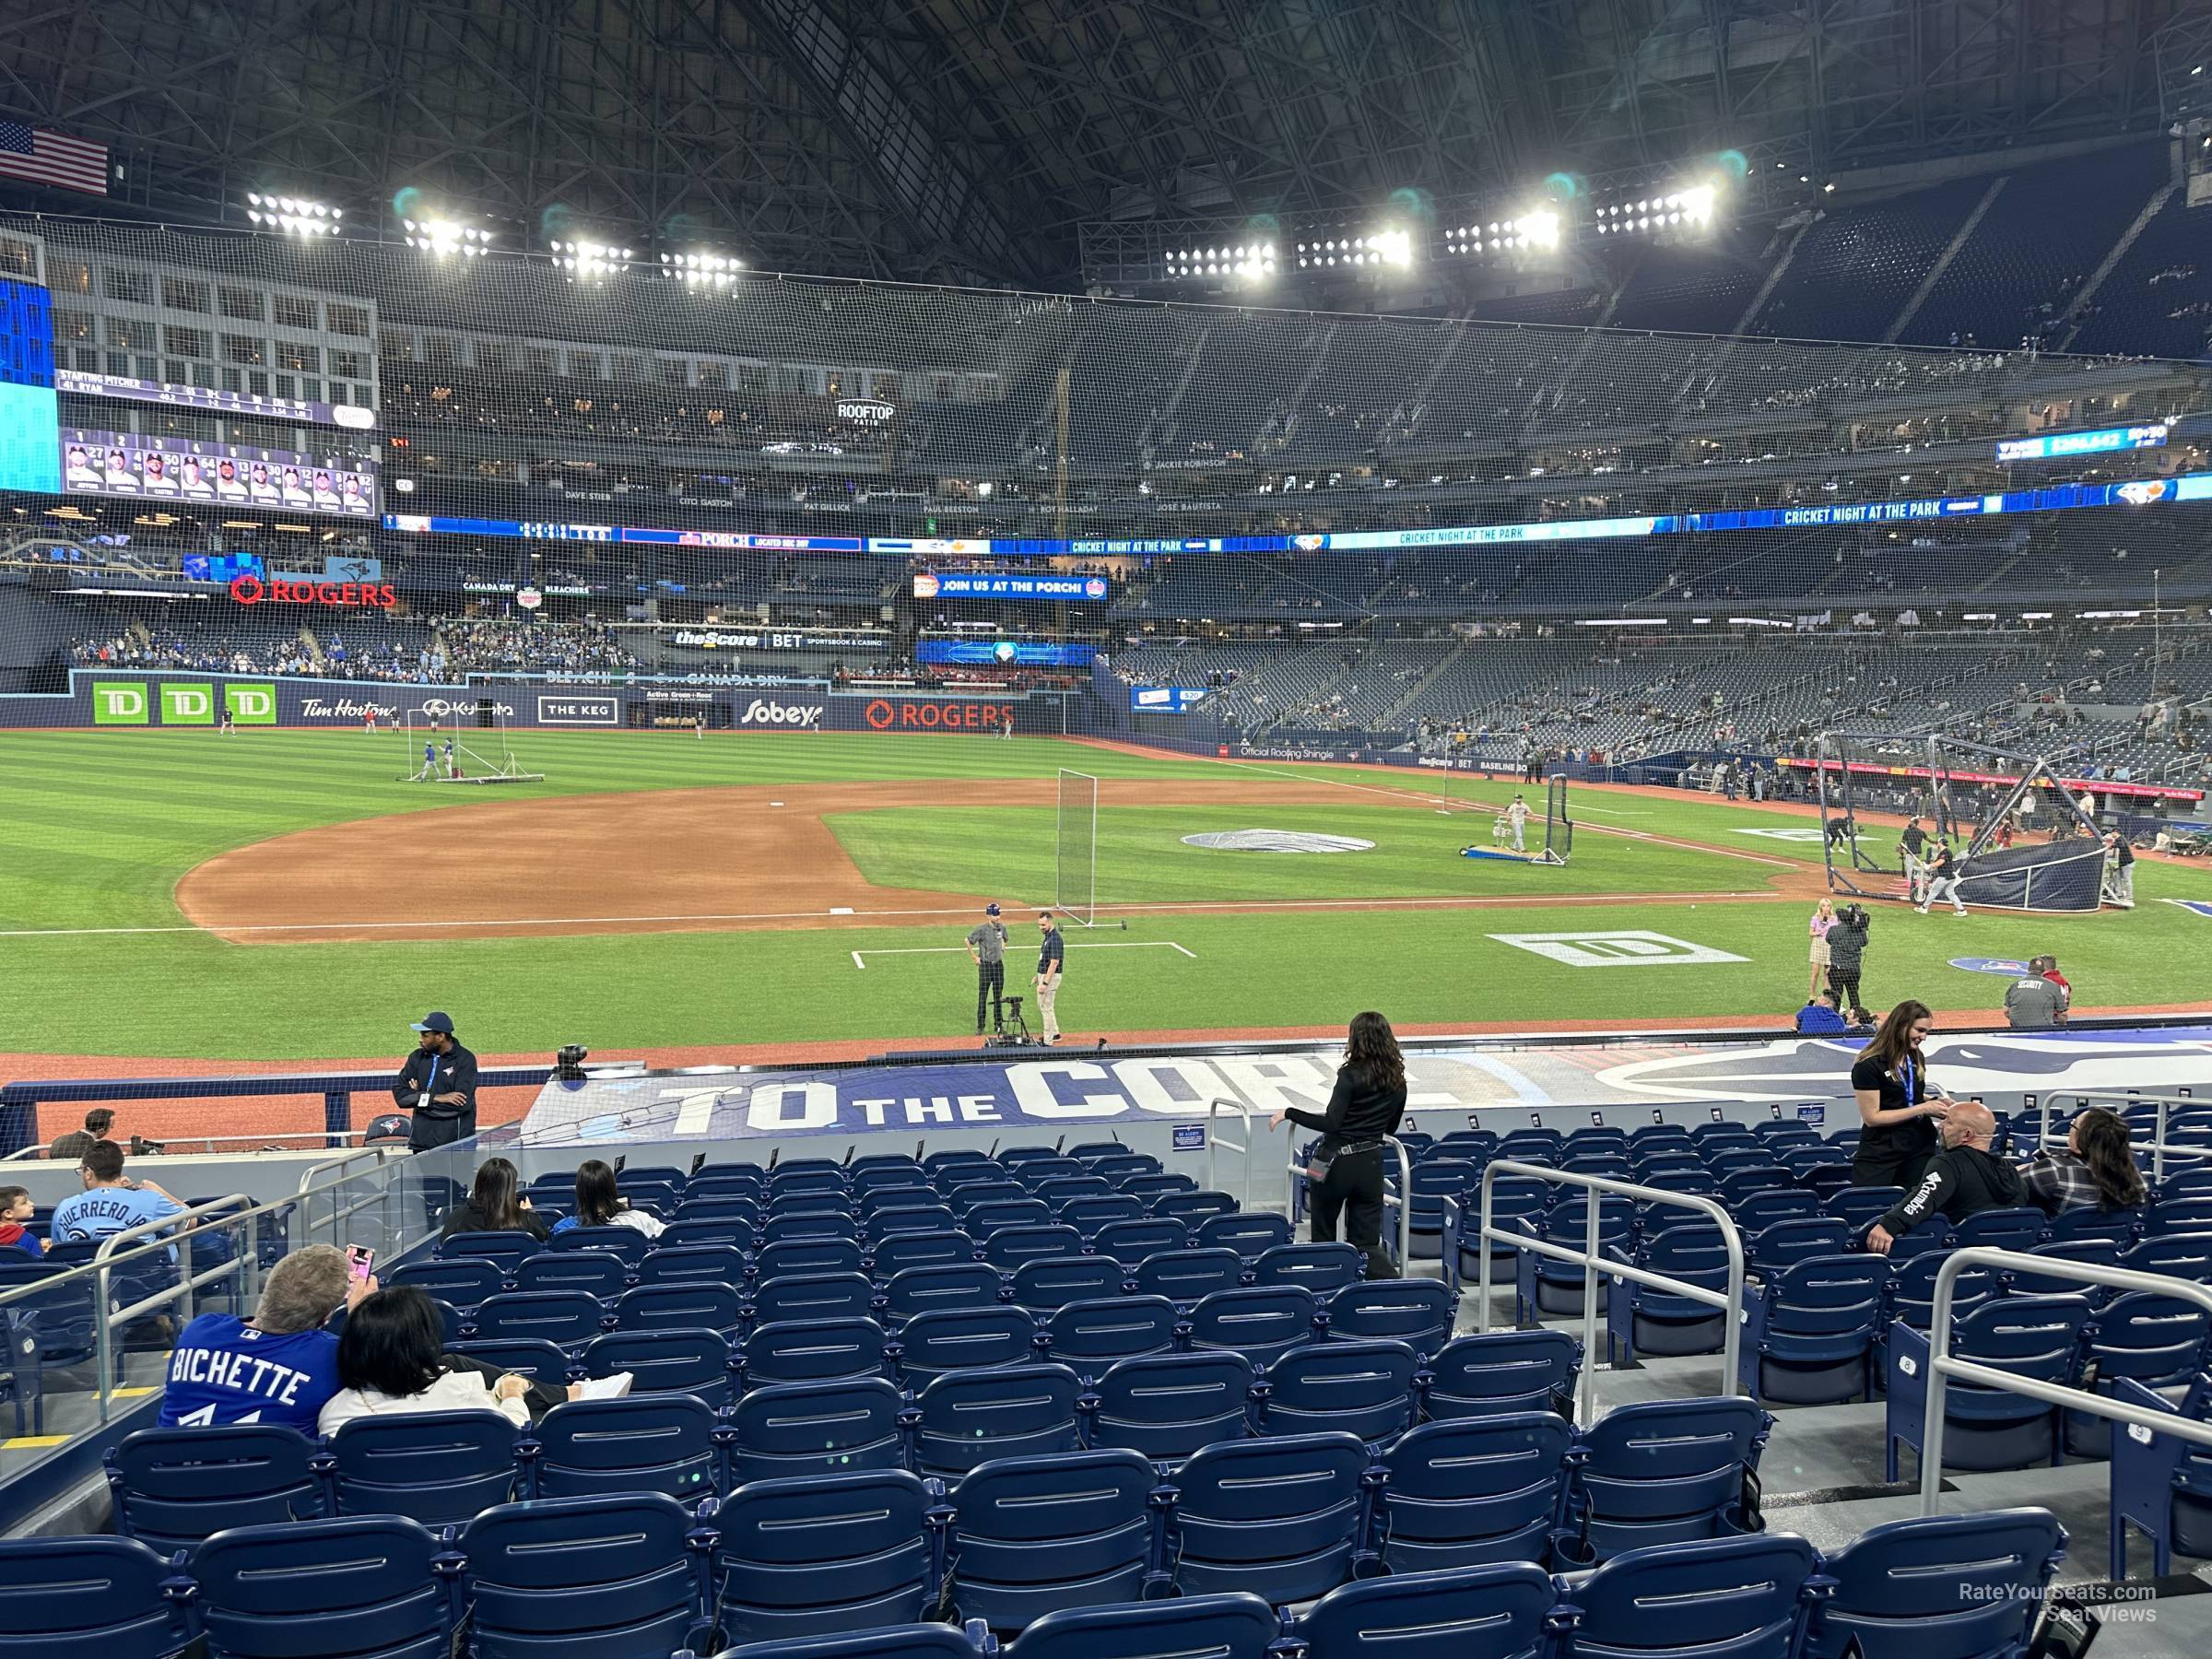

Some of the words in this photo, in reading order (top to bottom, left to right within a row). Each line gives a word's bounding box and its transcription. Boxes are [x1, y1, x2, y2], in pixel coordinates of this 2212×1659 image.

[79, 382, 103, 393] RYAN
[838, 405, 894, 419] ROOFTOP
[88, 446, 104, 459] 27
[164, 454, 179, 465] 50
[200, 457, 215, 469] 64
[238, 462, 249, 472] 13
[565, 491, 585, 500] DAVE
[588, 492, 610, 501] STIEB
[700, 499, 733, 507] GASTON
[820, 503, 851, 512] GILLICK
[1784, 508, 1830, 524] CRICKET
[1833, 506, 1867, 522] NIGHT
[1869, 505, 1882, 519] AT
[1885, 503, 1908, 518] THE
[1910, 501, 1941, 517] PARK
[700, 532, 749, 547] PORCH
[1400, 532, 1435, 544] CRICKET
[1438, 531, 1465, 541] NIGHT
[1466, 530, 1477, 540] AT
[1480, 529, 1496, 540] THE
[1500, 528, 1523, 538] PARK
[1072, 541, 1105, 553] CRICKET
[1108, 541, 1132, 552] NIGHT
[1133, 540, 1144, 551] AT
[1145, 540, 1159, 551] THE
[1161, 540, 1182, 551] PARK
[271, 580, 397, 608] ROGERS
[463, 582, 498, 591] CANADA
[499, 583, 515, 592] DRY
[545, 586, 589, 594] BLEACHERS
[943, 581, 970, 591] JOIN
[972, 581, 990, 591] US
[992, 582, 1009, 592] AT
[1011, 582, 1032, 592] THE
[1036, 582, 1082, 594] PORCH!
[675, 631, 759, 646] theScore
[772, 634, 803, 648] BET
[806, 638, 850, 646] SPORTSBOOK
[99, 689, 143, 715] TD
[166, 690, 208, 715] TD
[230, 691, 270, 716] TD
[301, 700, 331, 717] Tim
[547, 705, 576, 714] THE
[582, 705, 608, 715] KEG
[902, 705, 1014, 727] ROGERS
[1241, 747, 1269, 757] Official
[1271, 747, 1301, 759] Roofing
[1302, 749, 1335, 760] Shingle
[1458, 759, 1472, 768] BET
[1480, 761, 1515, 771] BASELINE
[659, 1082, 838, 1135] TO
[852, 1095, 1003, 1125] THE
[58, 1201, 130, 1231] GUERRERO
[1904, 1359, 1911, 1371] 8
[171, 1347, 312, 1406] BICHETTE
